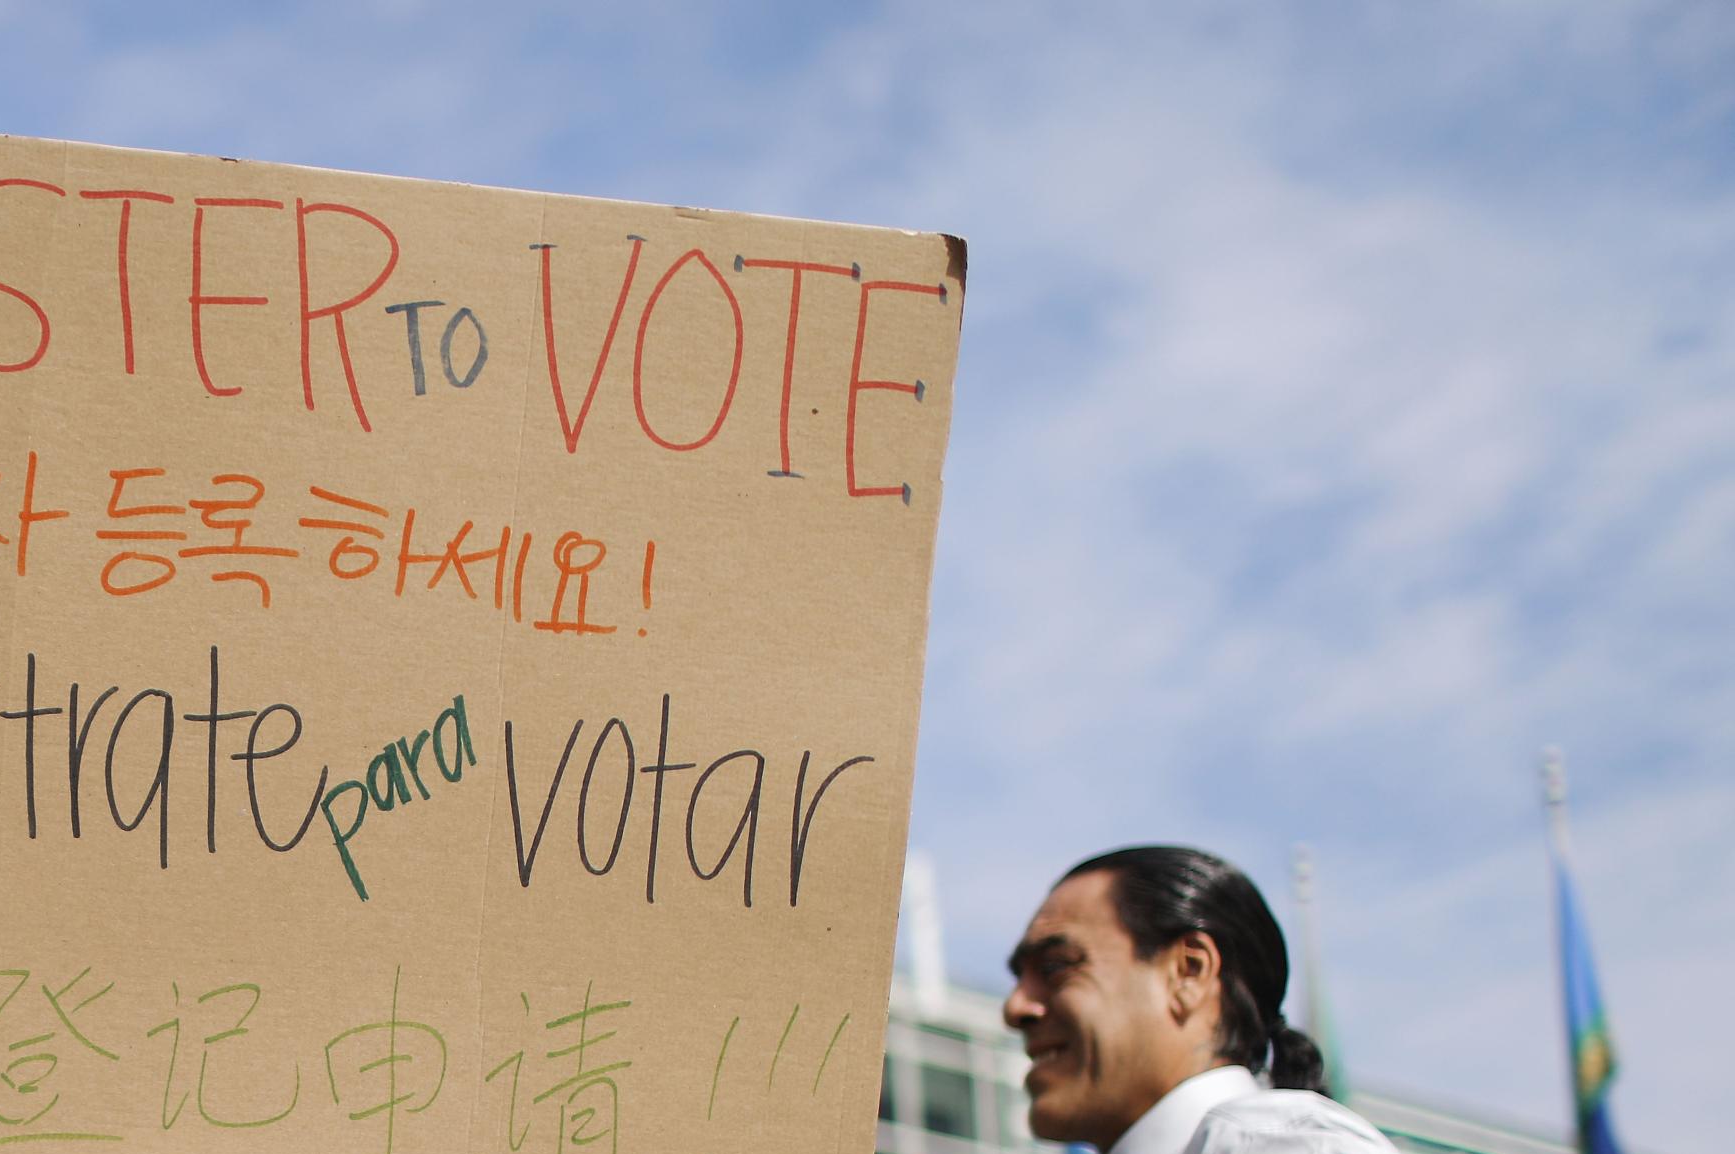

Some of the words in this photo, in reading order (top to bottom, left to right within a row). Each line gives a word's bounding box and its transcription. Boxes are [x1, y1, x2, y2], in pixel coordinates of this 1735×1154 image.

[386, 300, 489, 396] TO
[530, 235, 948, 506] VOTE
[320, 694, 477, 902] para
[504, 693, 876, 908] votar
